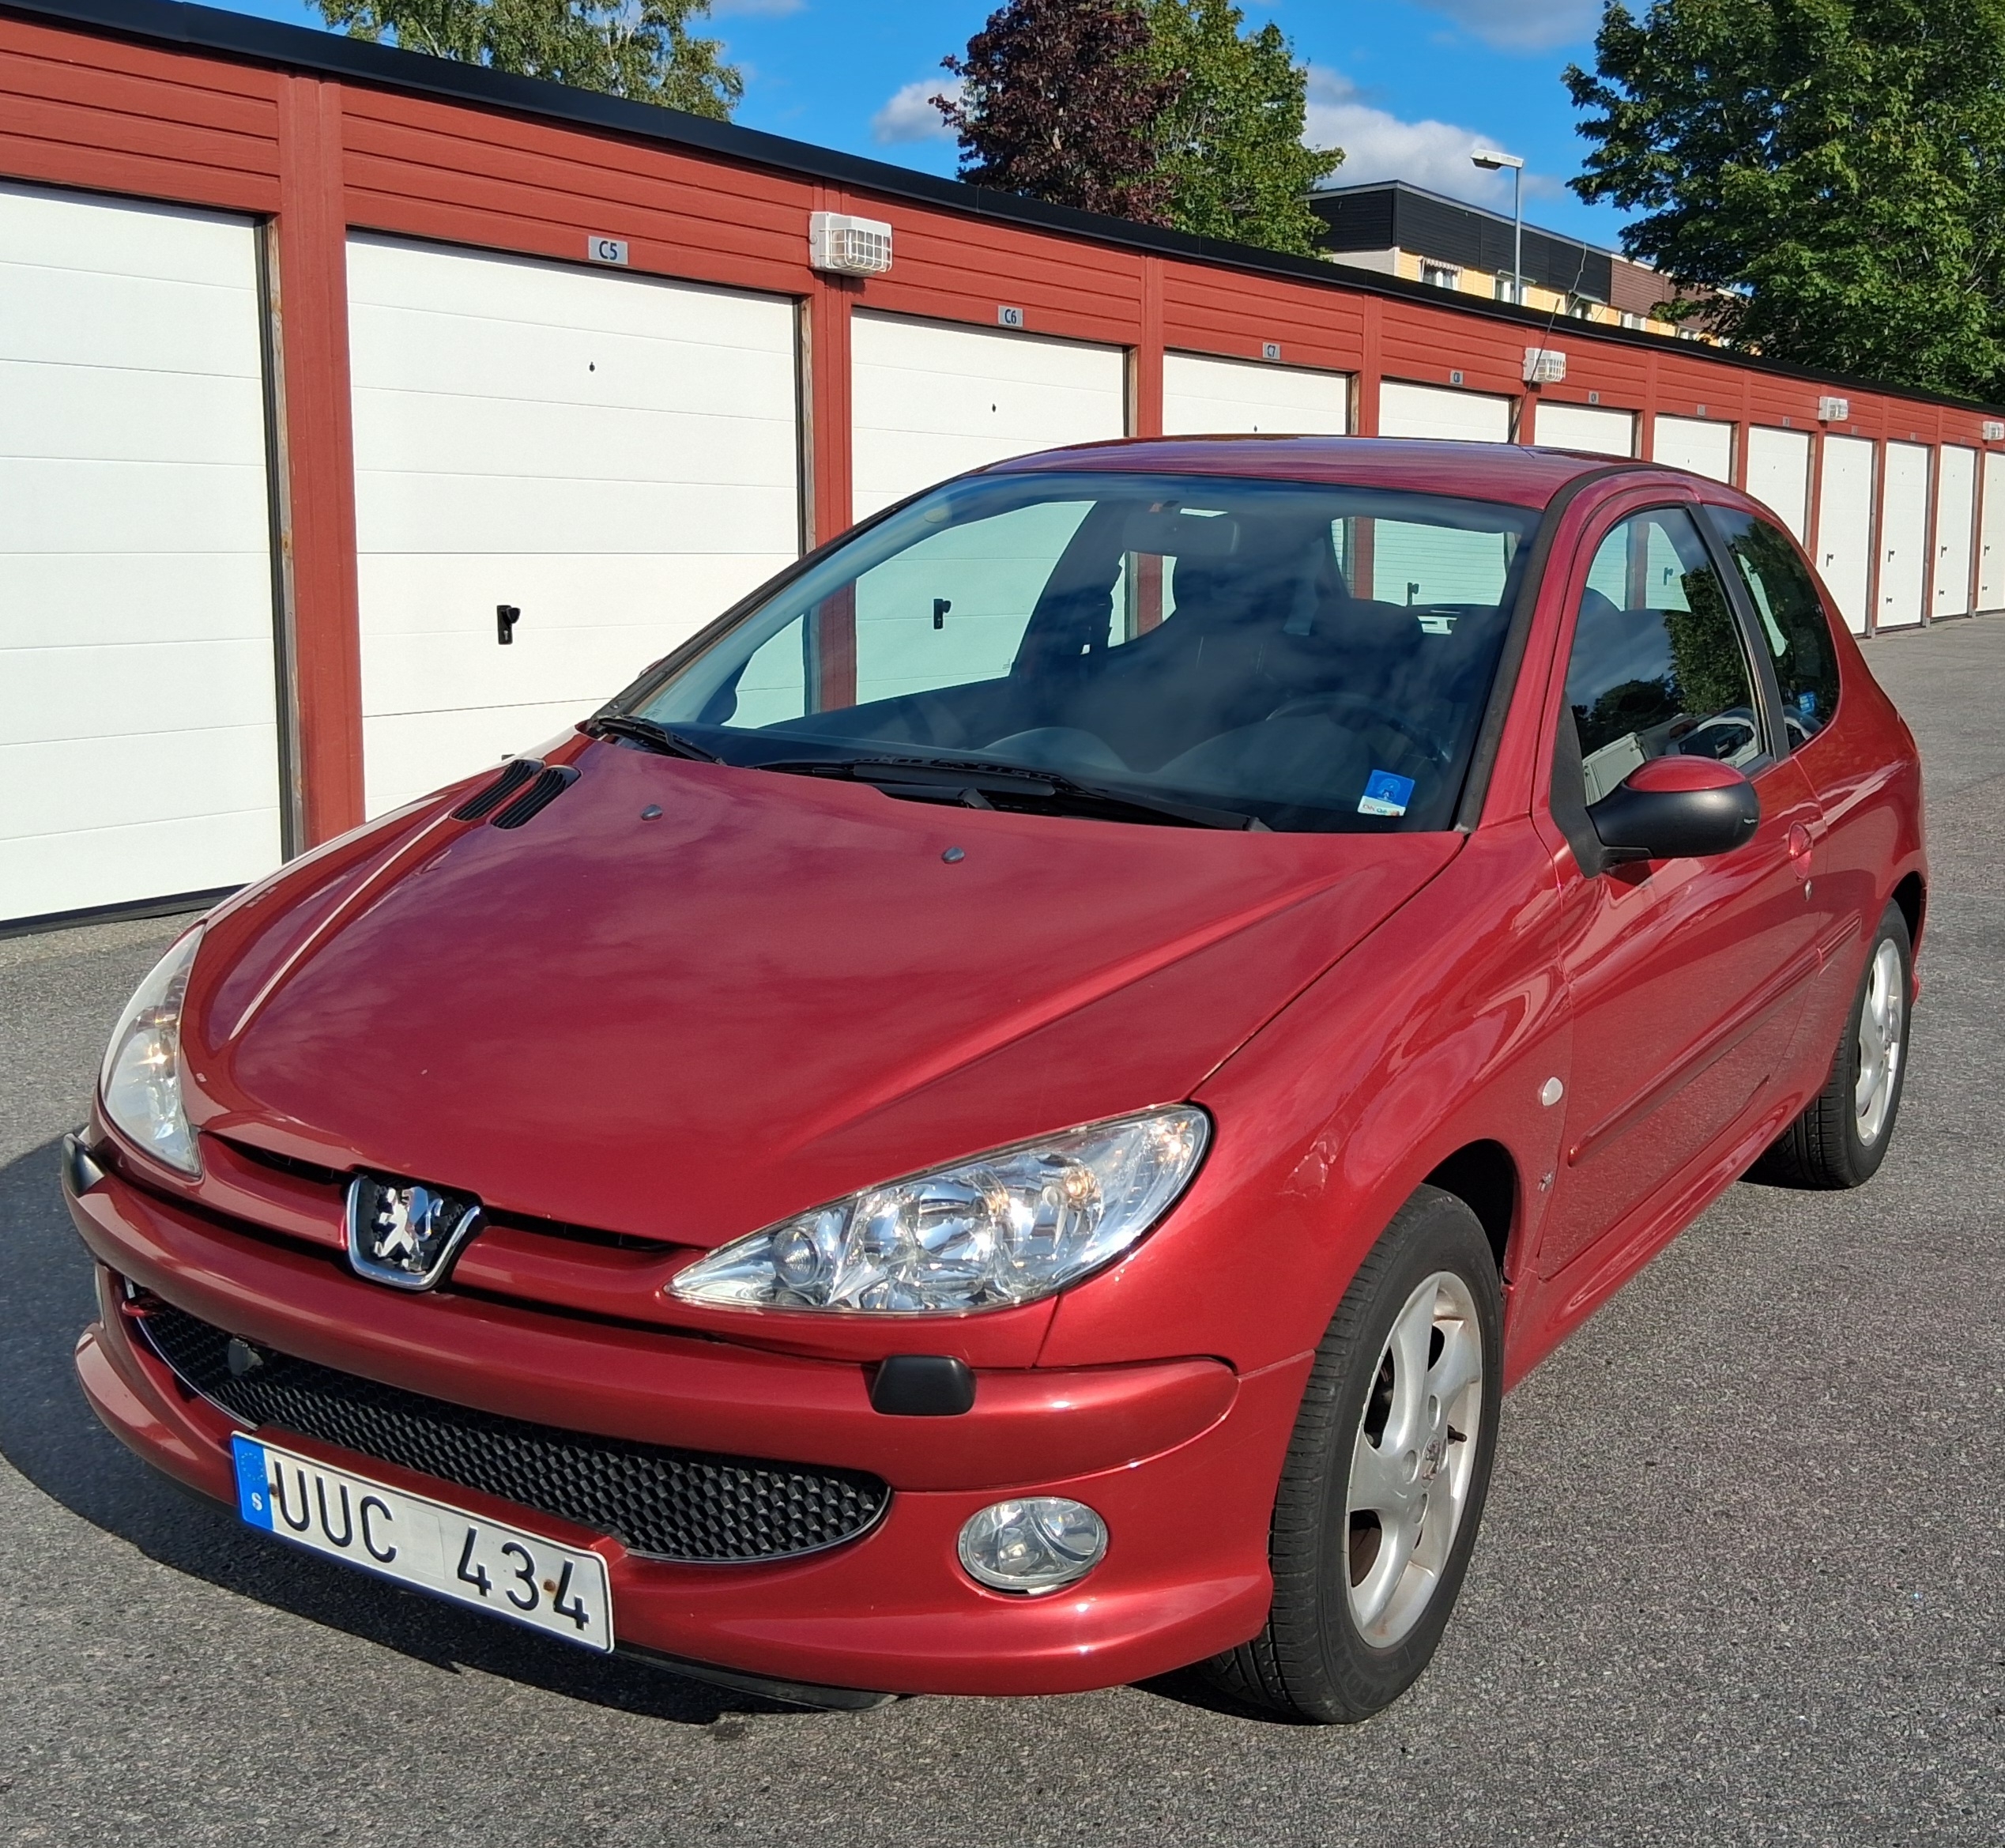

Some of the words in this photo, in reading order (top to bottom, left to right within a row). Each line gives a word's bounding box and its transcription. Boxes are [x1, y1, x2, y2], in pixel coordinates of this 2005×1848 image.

[599, 240, 617, 261] C5
[1004, 308, 1016, 325] C6
[251, 1492, 262, 1510] S
[273, 1460, 397, 1563] UUC
[458, 1526, 590, 1631] 434
